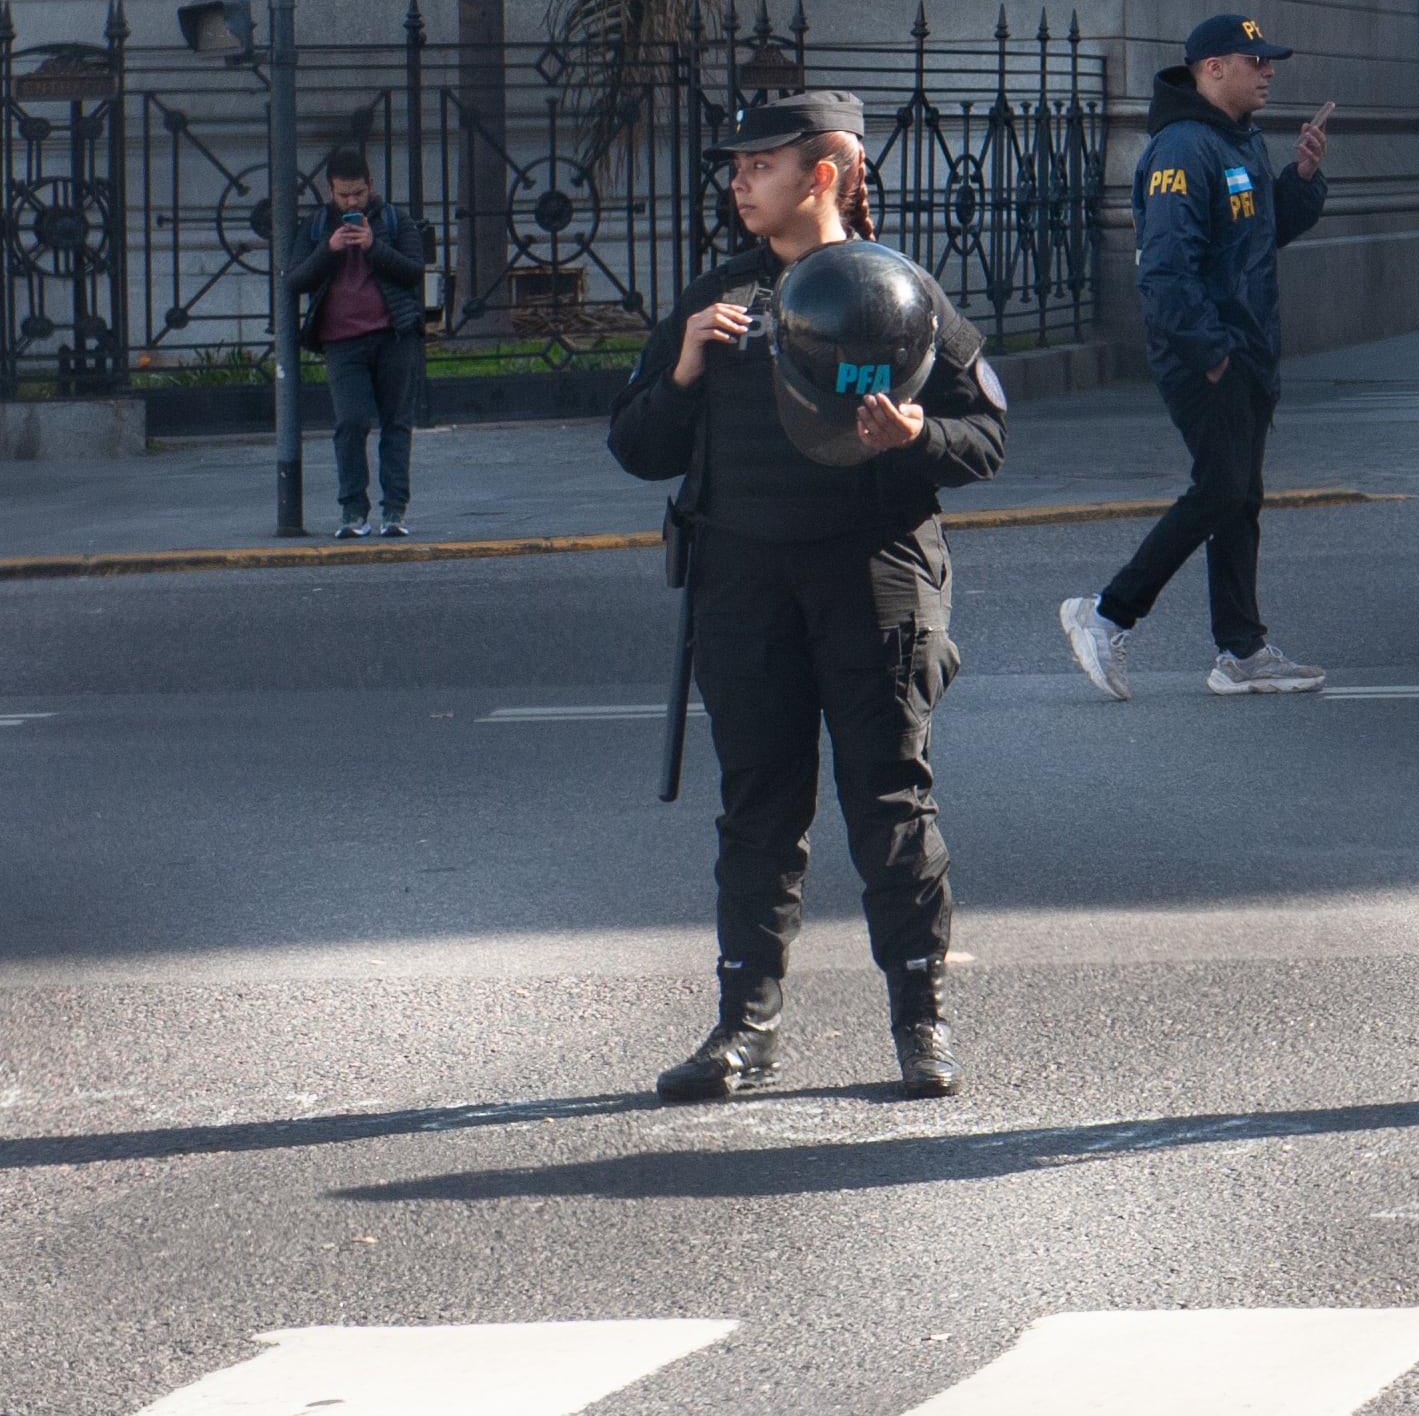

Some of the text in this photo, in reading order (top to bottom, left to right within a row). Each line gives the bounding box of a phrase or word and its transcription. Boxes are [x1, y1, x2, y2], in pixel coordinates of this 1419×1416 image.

[1242, 20, 1263, 40] PF
[1148, 168, 1187, 196] PFA
[835, 362, 890, 395] PFA
